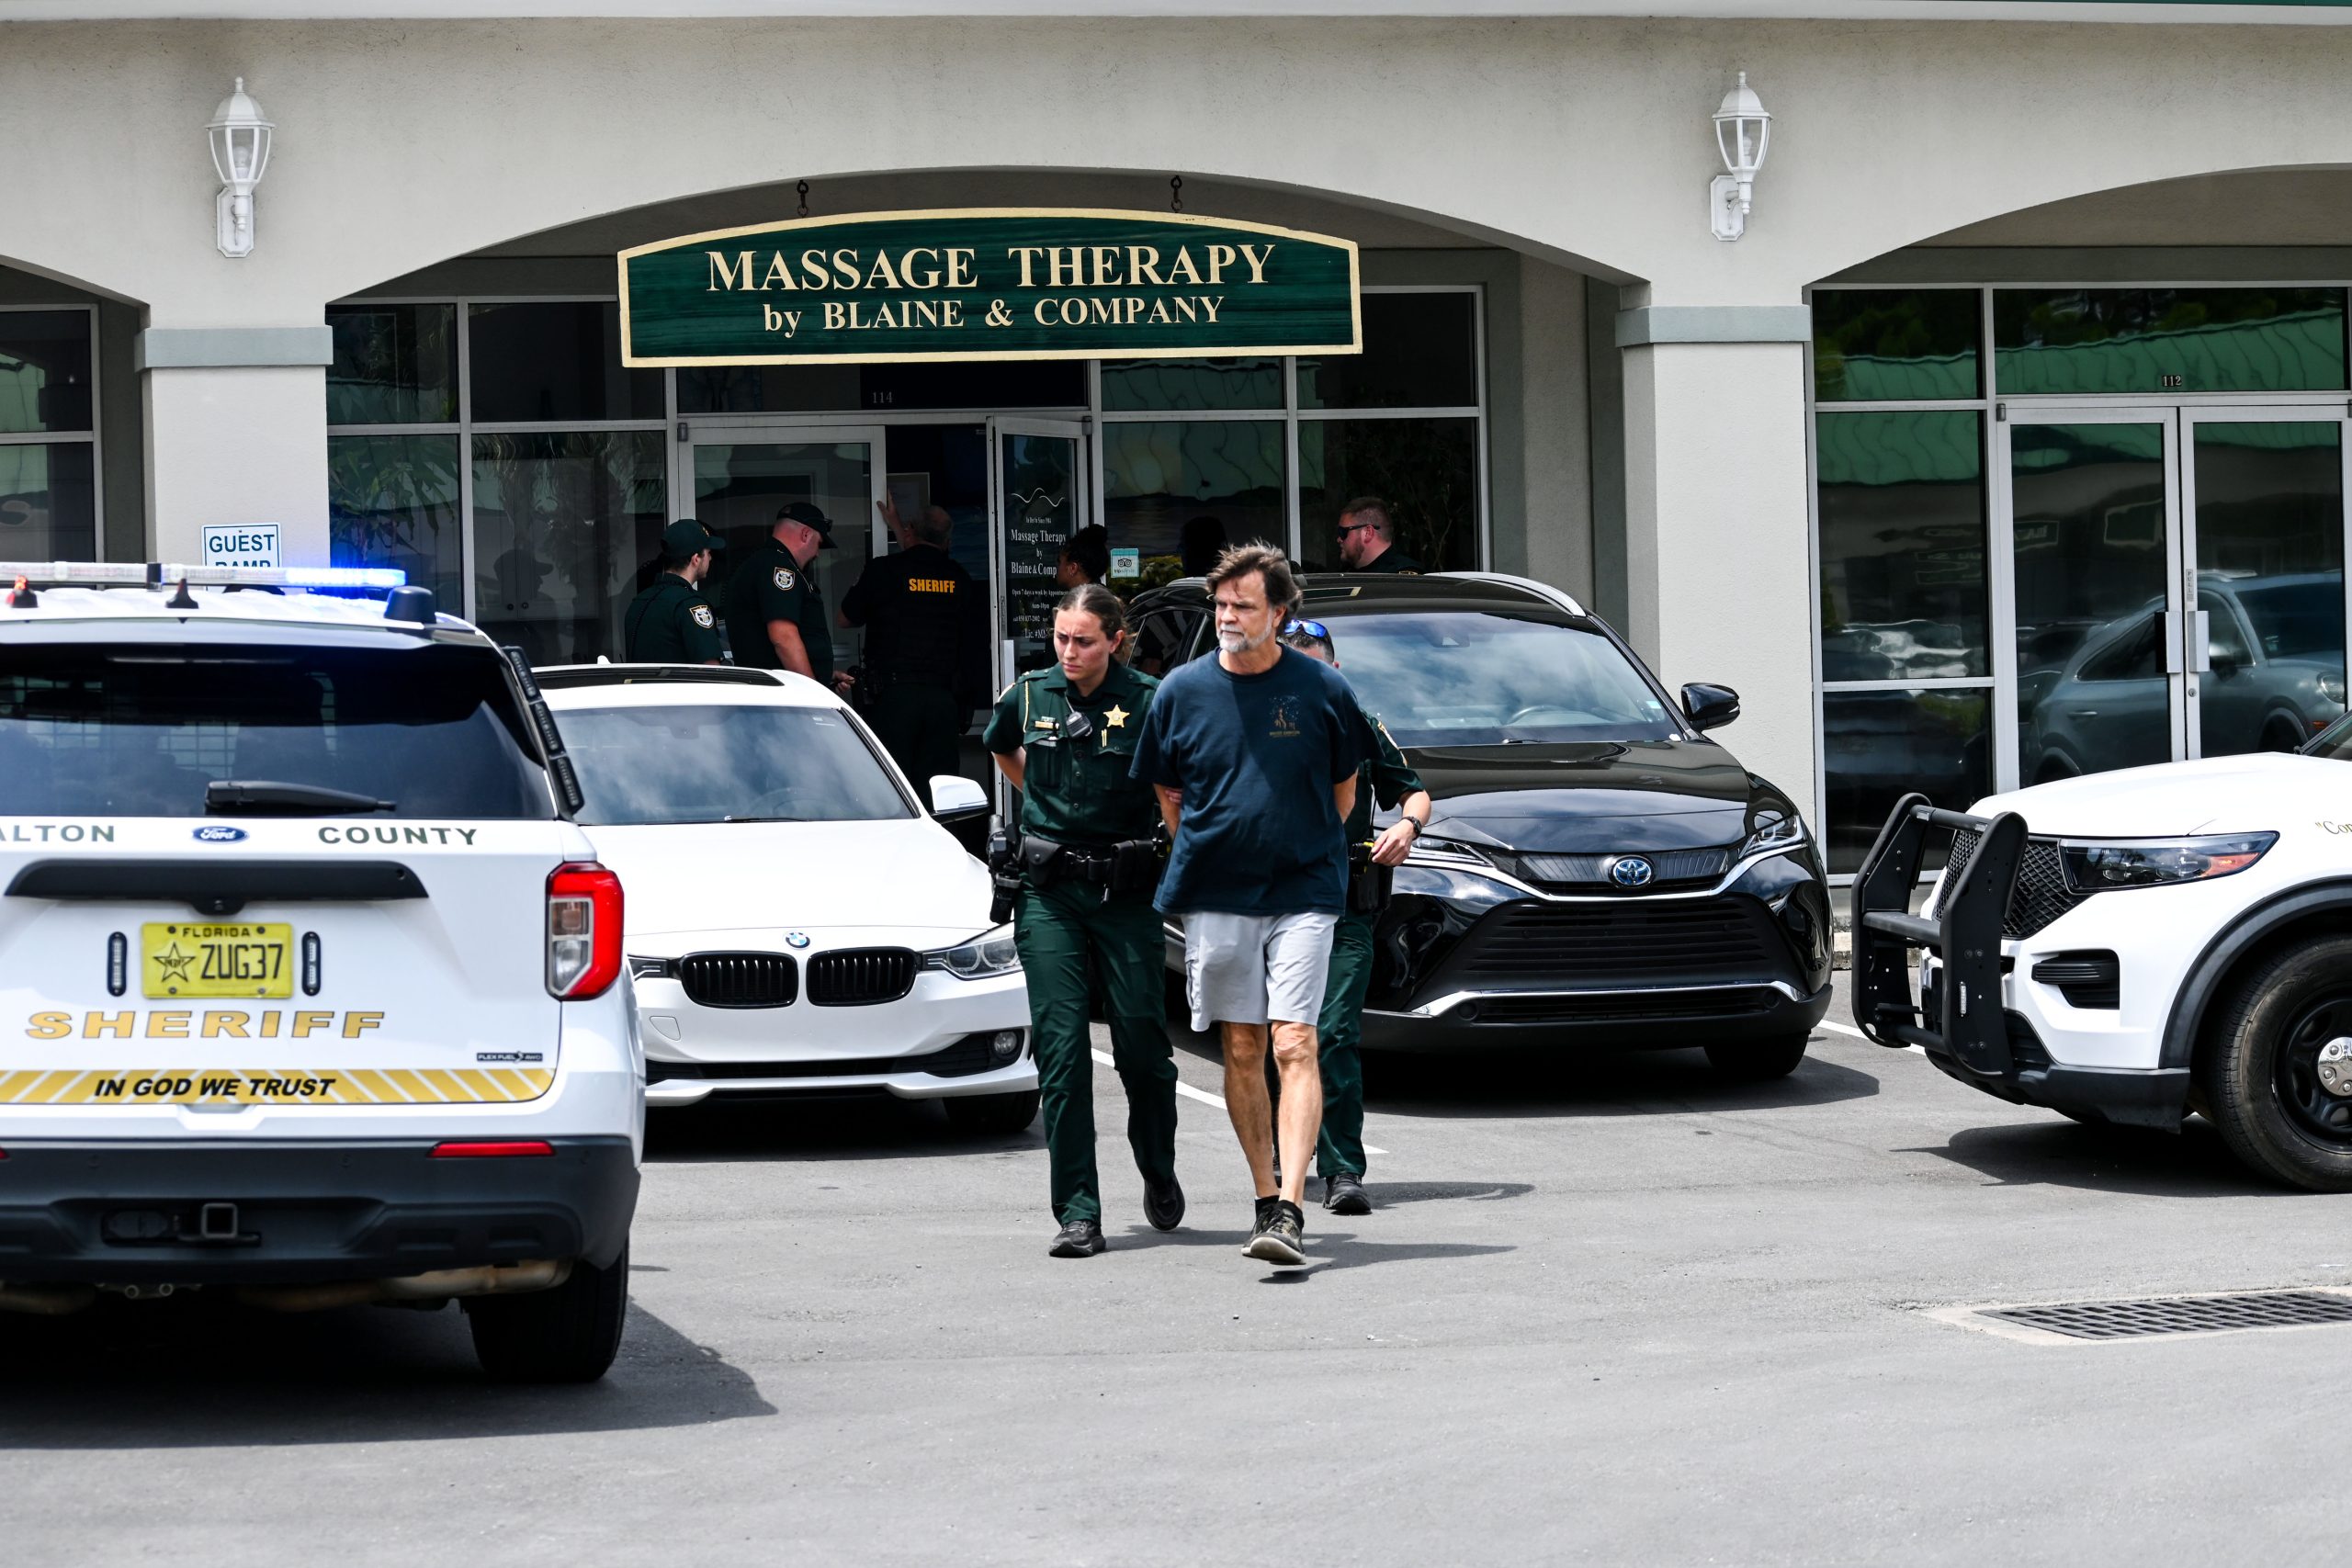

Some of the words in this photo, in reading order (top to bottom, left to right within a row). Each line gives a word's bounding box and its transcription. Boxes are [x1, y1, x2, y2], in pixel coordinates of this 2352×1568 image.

[707, 247, 978, 293] MASSAGE
[1009, 243, 1276, 288] THERAPY
[764, 303, 801, 338] by
[822, 299, 965, 331] BLAINE
[985, 299, 1014, 327] &
[1035, 296, 1225, 326] COMPANY
[2163, 375, 2182, 387] 112
[873, 391, 893, 404] 114
[209, 534, 275, 553] GUEST
[1011, 528, 1039, 545] Massage
[1039, 529, 1067, 546] Therapy
[1035, 547, 1043, 559] by
[1011, 561, 1033, 574] Blaine
[1032, 564, 1037, 574] &
[1037, 562, 1057, 579] Comp
[909, 578, 956, 593] SHERIFF
[0, 824, 115, 842] LTON
[199, 827, 237, 840] Ford
[317, 826, 478, 845] COUNTY
[182, 927, 251, 938] FLORIDA
[200, 943, 283, 980] ZUG37
[26, 1010, 385, 1039] SHERIFF
[95, 1078, 126, 1097] IN
[132, 1078, 192, 1097] GOD
[199, 1078, 242, 1096] WE
[249, 1078, 337, 1096] TRUST
